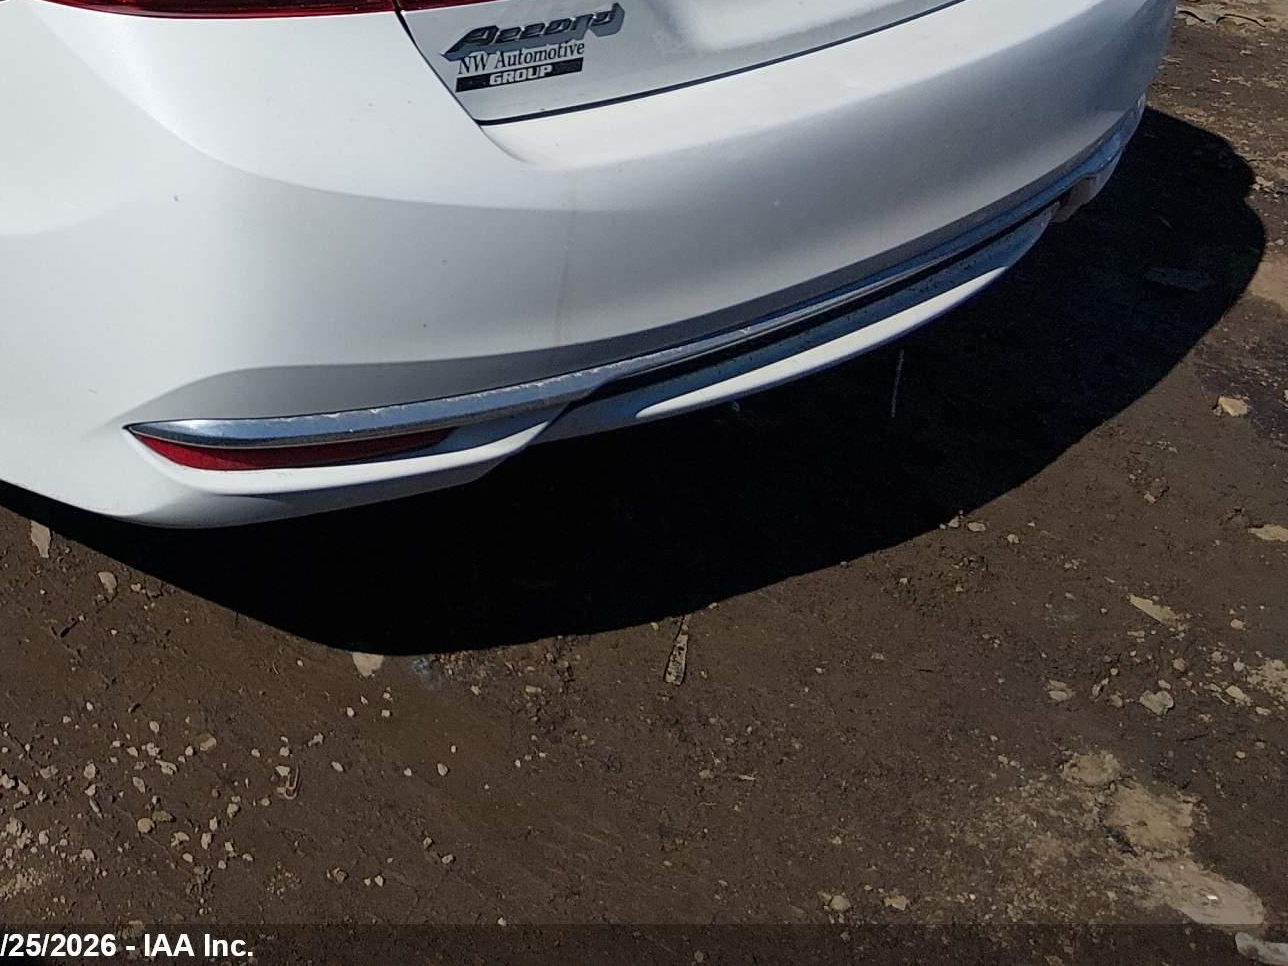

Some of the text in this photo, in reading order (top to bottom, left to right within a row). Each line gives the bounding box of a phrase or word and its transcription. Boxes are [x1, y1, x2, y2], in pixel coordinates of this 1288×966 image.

[440, 2, 624, 59] Accord
[458, 41, 585, 75] NW Automotive
[489, 64, 553, 86] GROUP
